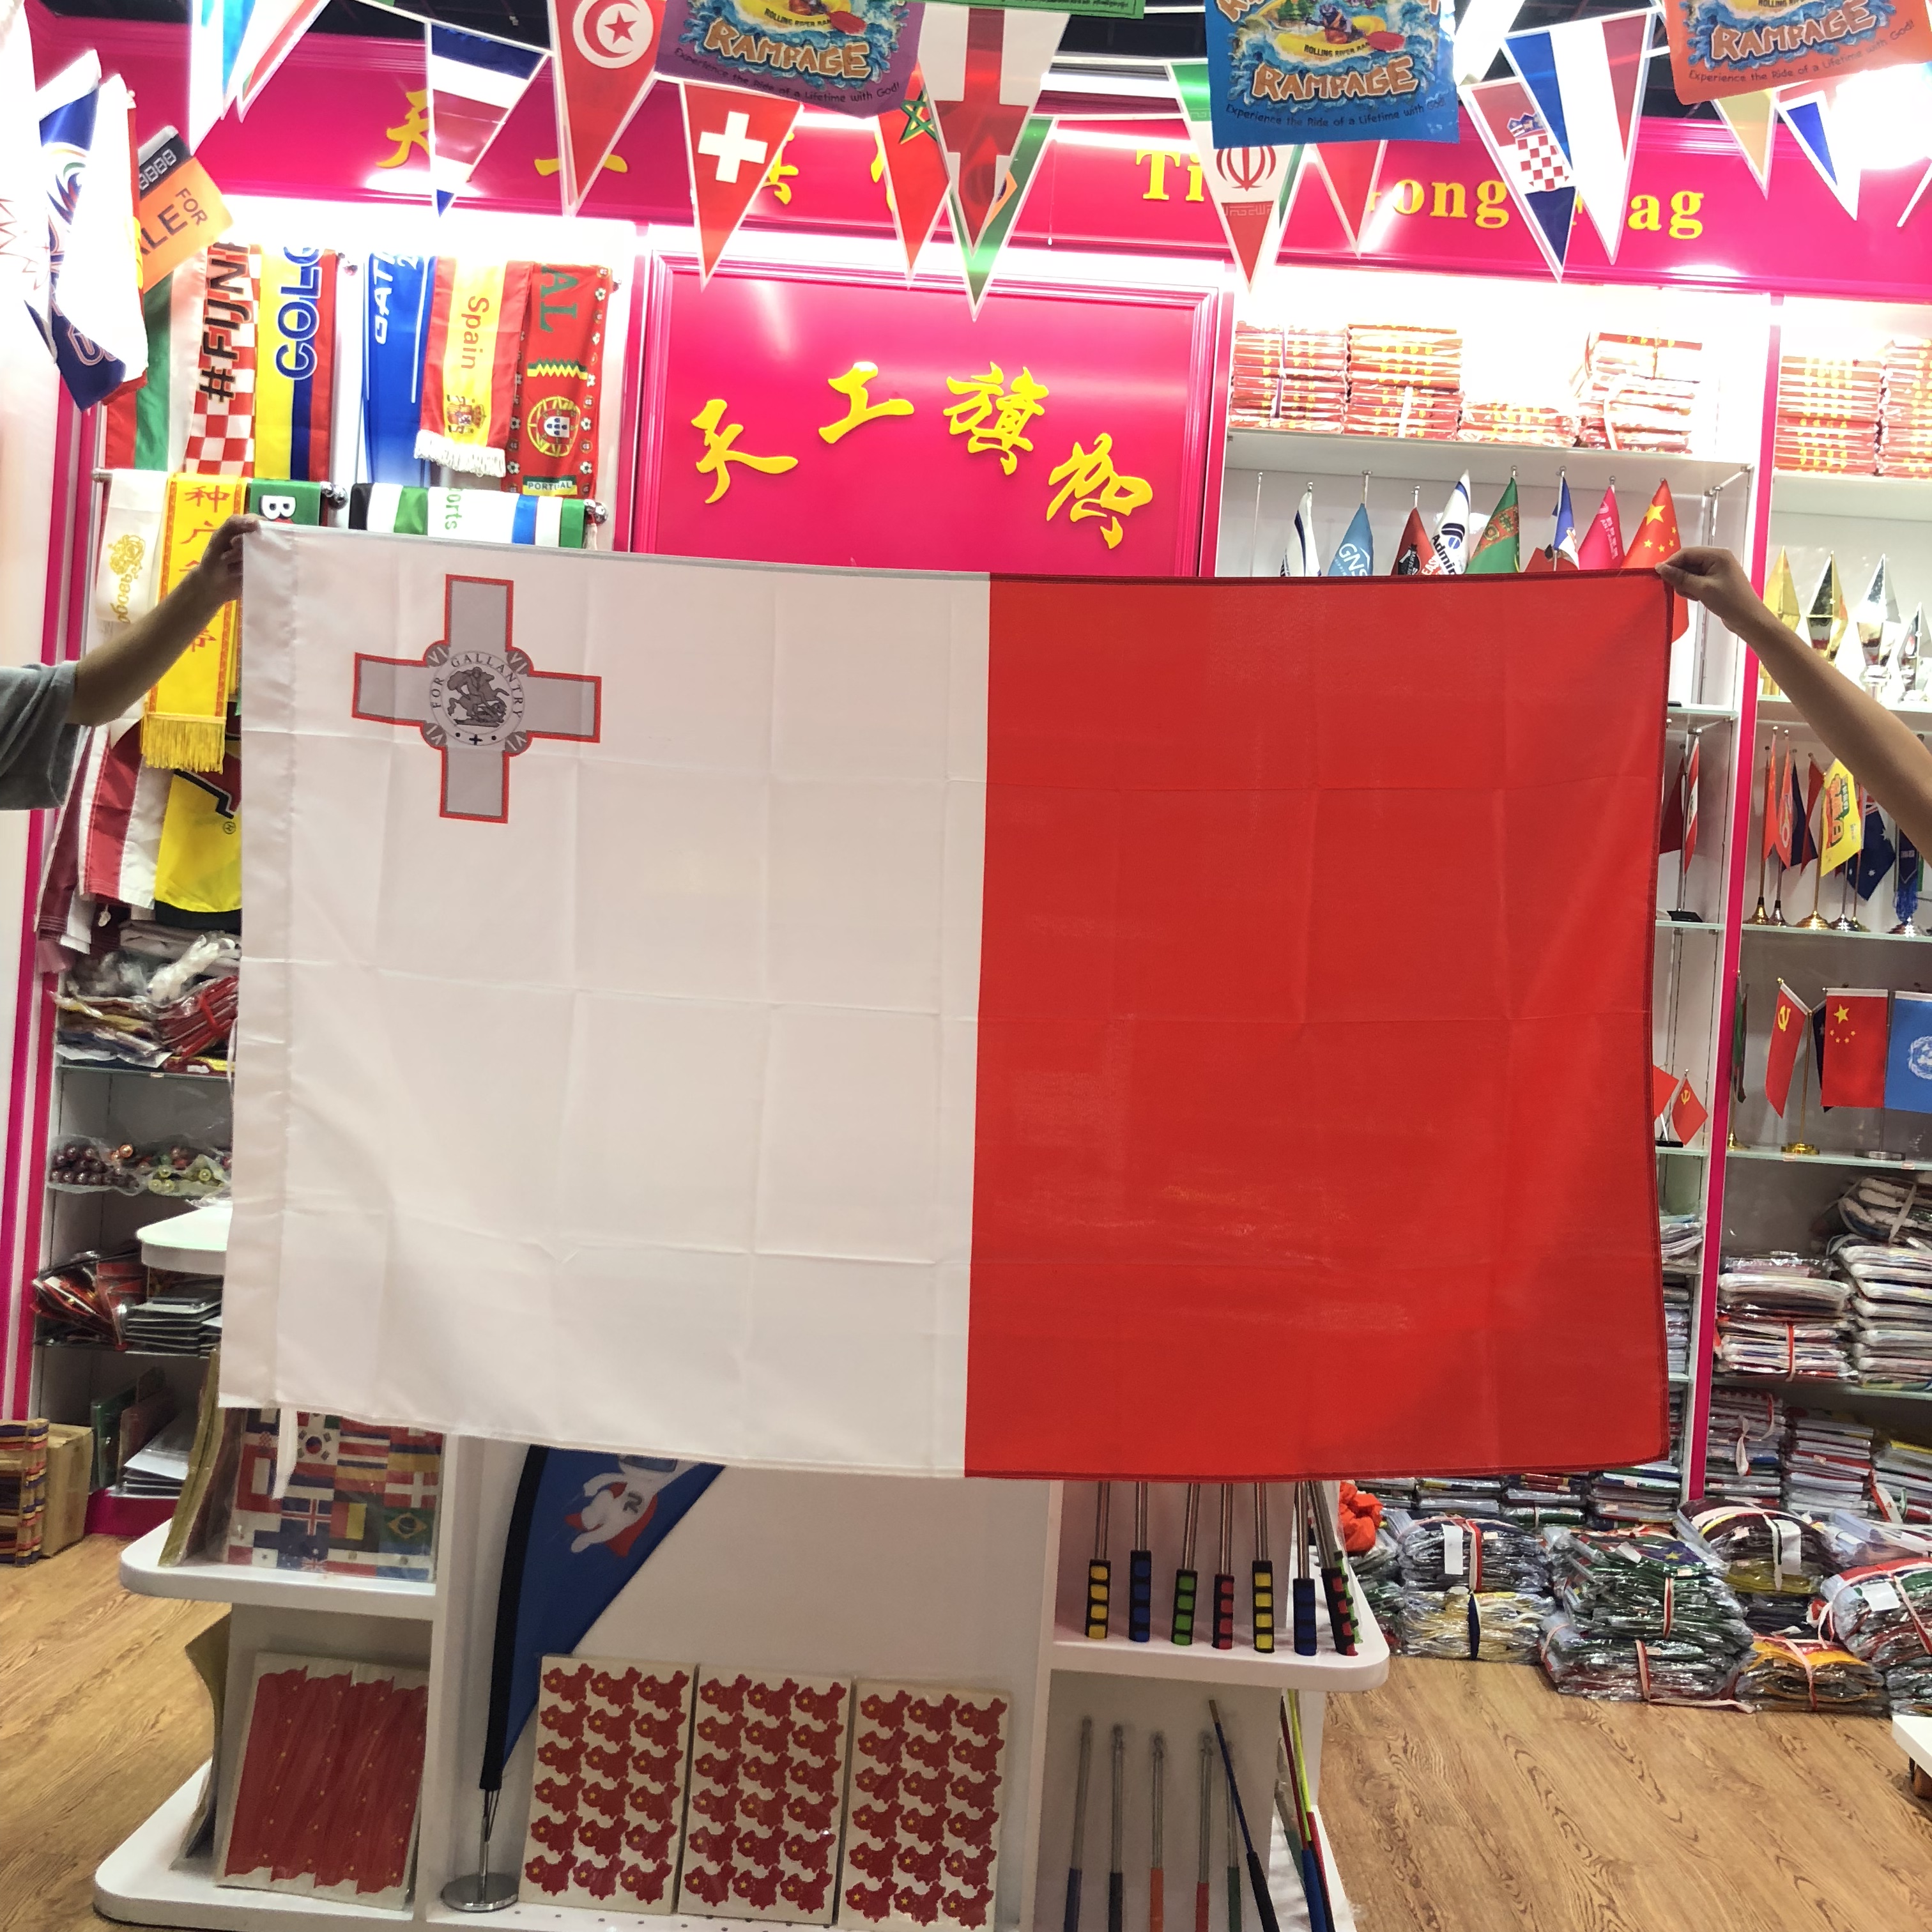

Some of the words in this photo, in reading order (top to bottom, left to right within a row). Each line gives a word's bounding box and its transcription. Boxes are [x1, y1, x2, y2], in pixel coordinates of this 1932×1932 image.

[703, 17, 872, 79] RAMPAGE
[1689, 70, 1746, 82] Experience
[1772, 69, 1793, 78] Ride
[1798, 65, 1807, 75] of
[1823, 51, 1863, 69] Lifetime
[1866, 39, 1888, 54] with
[1890, 19, 1914, 40] God!
[1711, 0, 1877, 61] RAMPAGE
[674, 48, 729, 78] Experience
[733, 71, 749, 86] the
[753, 79, 774, 92] Ride
[779, 86, 790, 96] of
[793, 91, 801, 99] a
[805, 90, 846, 103] Lifetime
[850, 91, 873, 102] with
[877, 82, 900, 98] God!
[1251, 55, 1419, 102] RAMPAGE
[1225, 103, 1282, 125] Experience
[1286, 116, 1303, 126] the
[1307, 117, 1328, 127] Ride
[1333, 117, 1344, 127] of
[1359, 111, 1400, 125] Lifetime
[1404, 104, 1424, 117] with
[175, 187, 208, 226] FOR
[1135, 149, 1205, 202] Ti
[1370, 179, 1510, 229] ong
[461, 295, 490, 370] Spain
[428, 646, 448, 664] VI
[510, 652, 528, 671] VI
[432, 677, 445, 709] FOR
[451, 653, 523, 718] GALLANTRY
